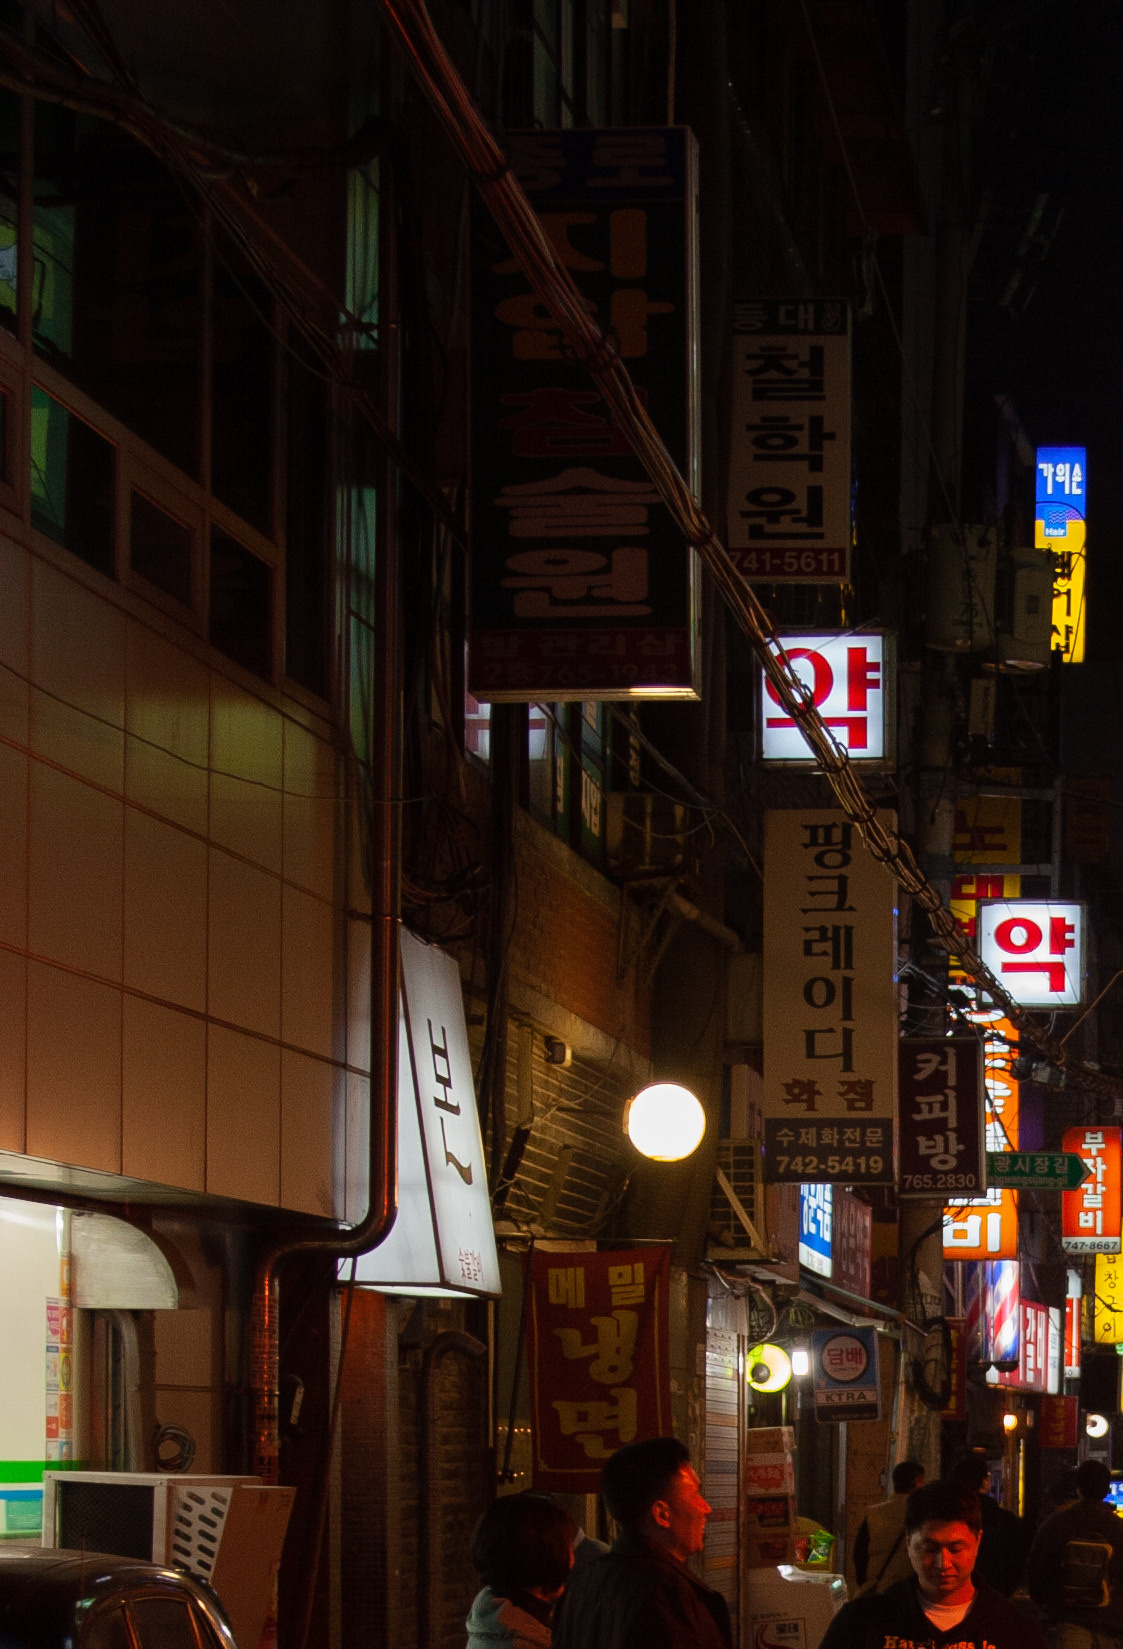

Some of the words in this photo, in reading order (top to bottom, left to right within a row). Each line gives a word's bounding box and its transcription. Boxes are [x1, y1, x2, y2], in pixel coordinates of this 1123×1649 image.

[740, 345, 836, 541] 철학원
[1038, 462, 1083, 495] 가위손
[765, 647, 882, 749] 약
[799, 822, 855, 1072] 핑크레이디
[994, 916, 1076, 993] 약
[911, 1046, 966, 1171] 커피방
[775, 1126, 885, 1148] 수제화전문
[775, 1154, 884, 1174] 742-5419
[903, 1173, 976, 1189] 765.2830
[986, 1154, 1069, 1175] 광시장길
[1079, 1131, 1107, 1235] 부자갈비
[547, 1260, 646, 1309] 메밀
[827, 1348, 864, 1366] 담배
